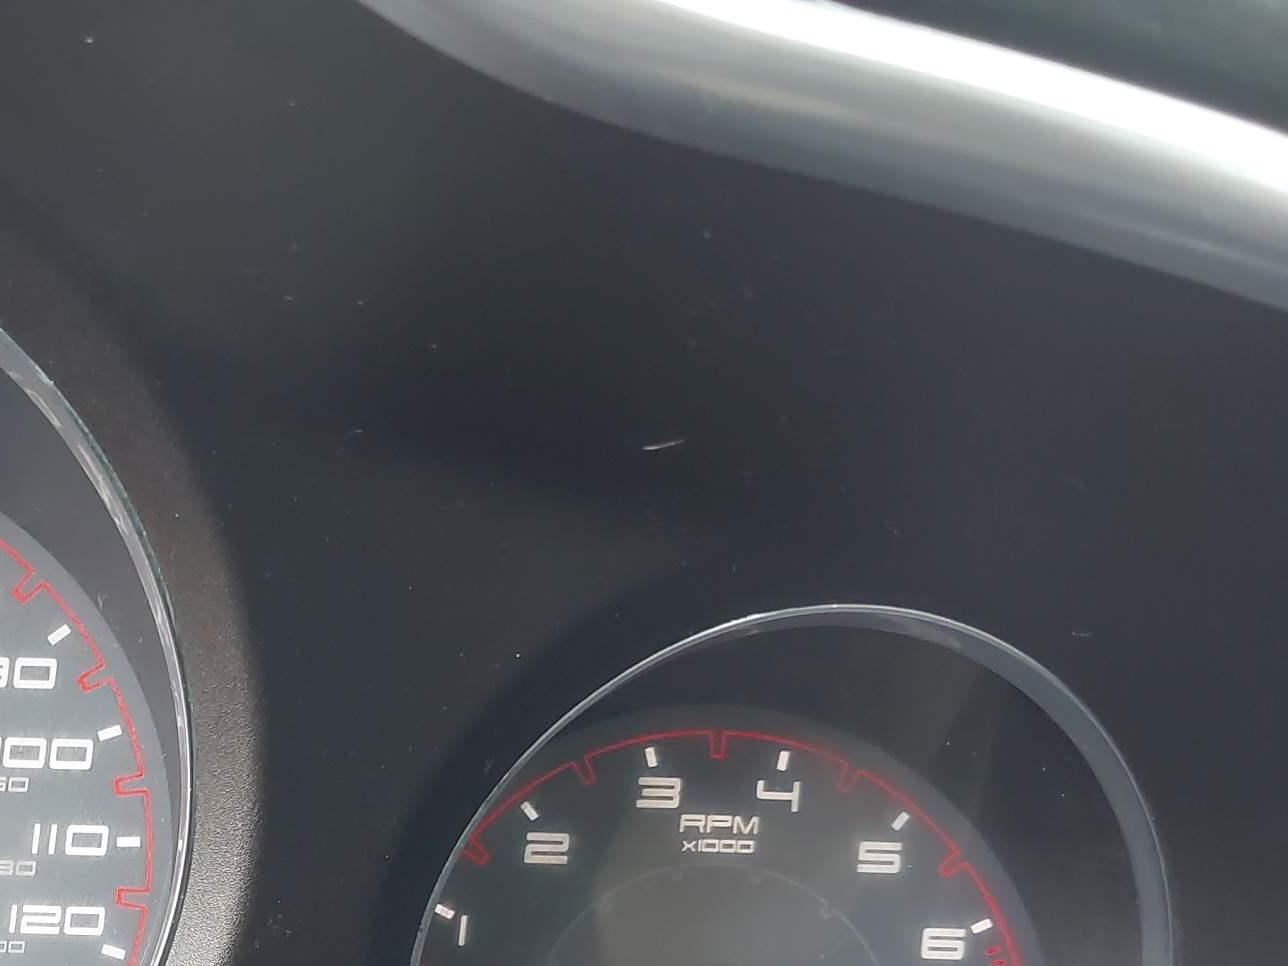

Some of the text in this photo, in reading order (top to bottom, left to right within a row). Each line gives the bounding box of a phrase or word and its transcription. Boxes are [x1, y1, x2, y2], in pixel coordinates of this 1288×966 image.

[636, 776, 681, 809] 3
[756, 779, 800, 812] 4
[31, 823, 109, 856] 110
[679, 814, 760, 835] RPM
[524, 832, 570, 865] 2
[857, 841, 902, 875] 5
[9, 903, 105, 936] 120
[457, 915, 468, 946] 1
[921, 927, 966, 960] 6
